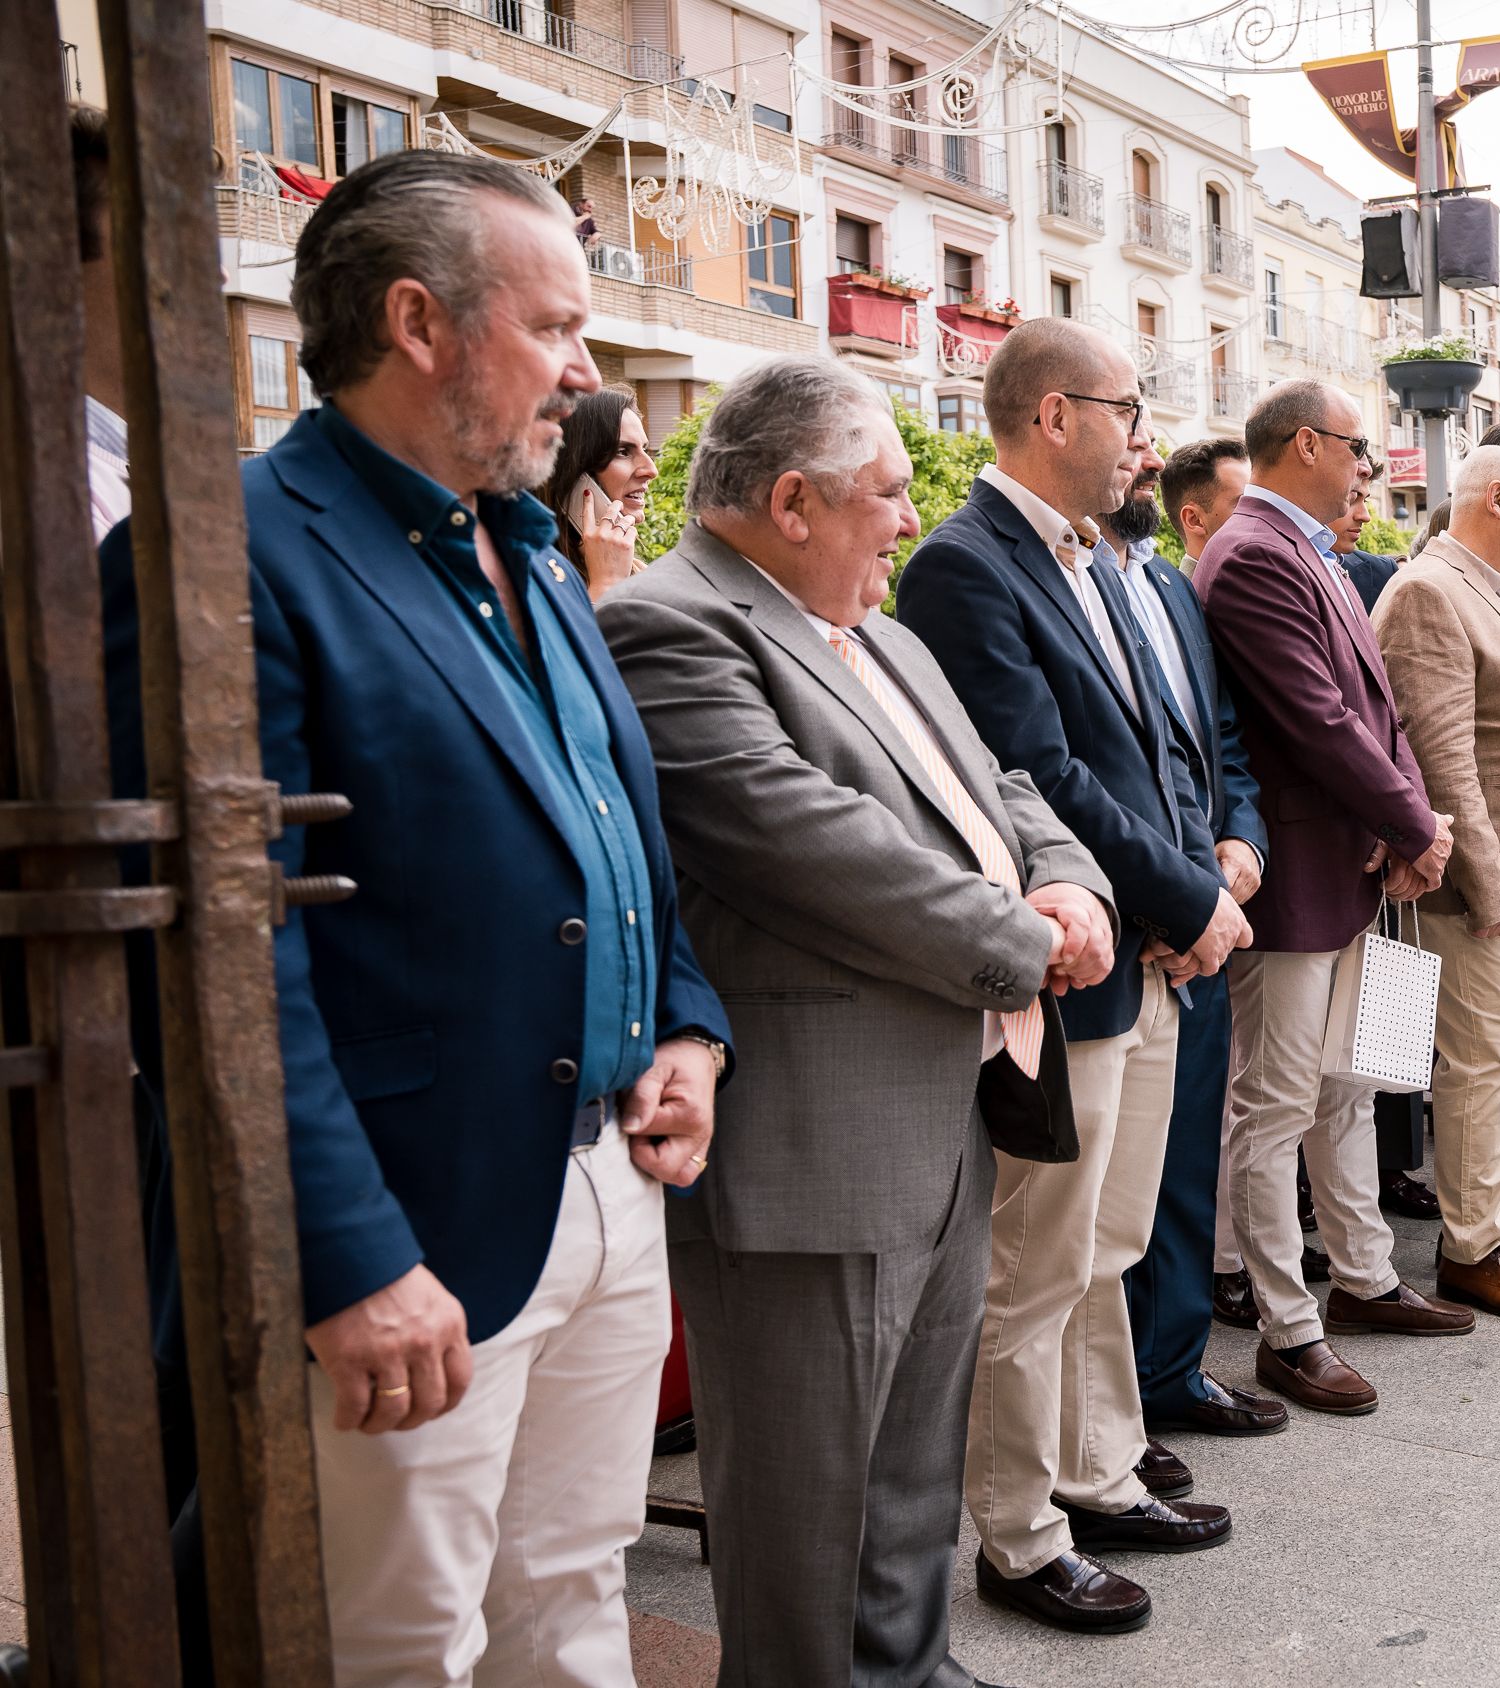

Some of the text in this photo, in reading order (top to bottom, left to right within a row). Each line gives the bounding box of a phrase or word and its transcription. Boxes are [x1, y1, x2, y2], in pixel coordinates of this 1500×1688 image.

[1330, 89, 1386, 108] HONOR DE
[1353, 101, 1388, 115] PUEBLO
